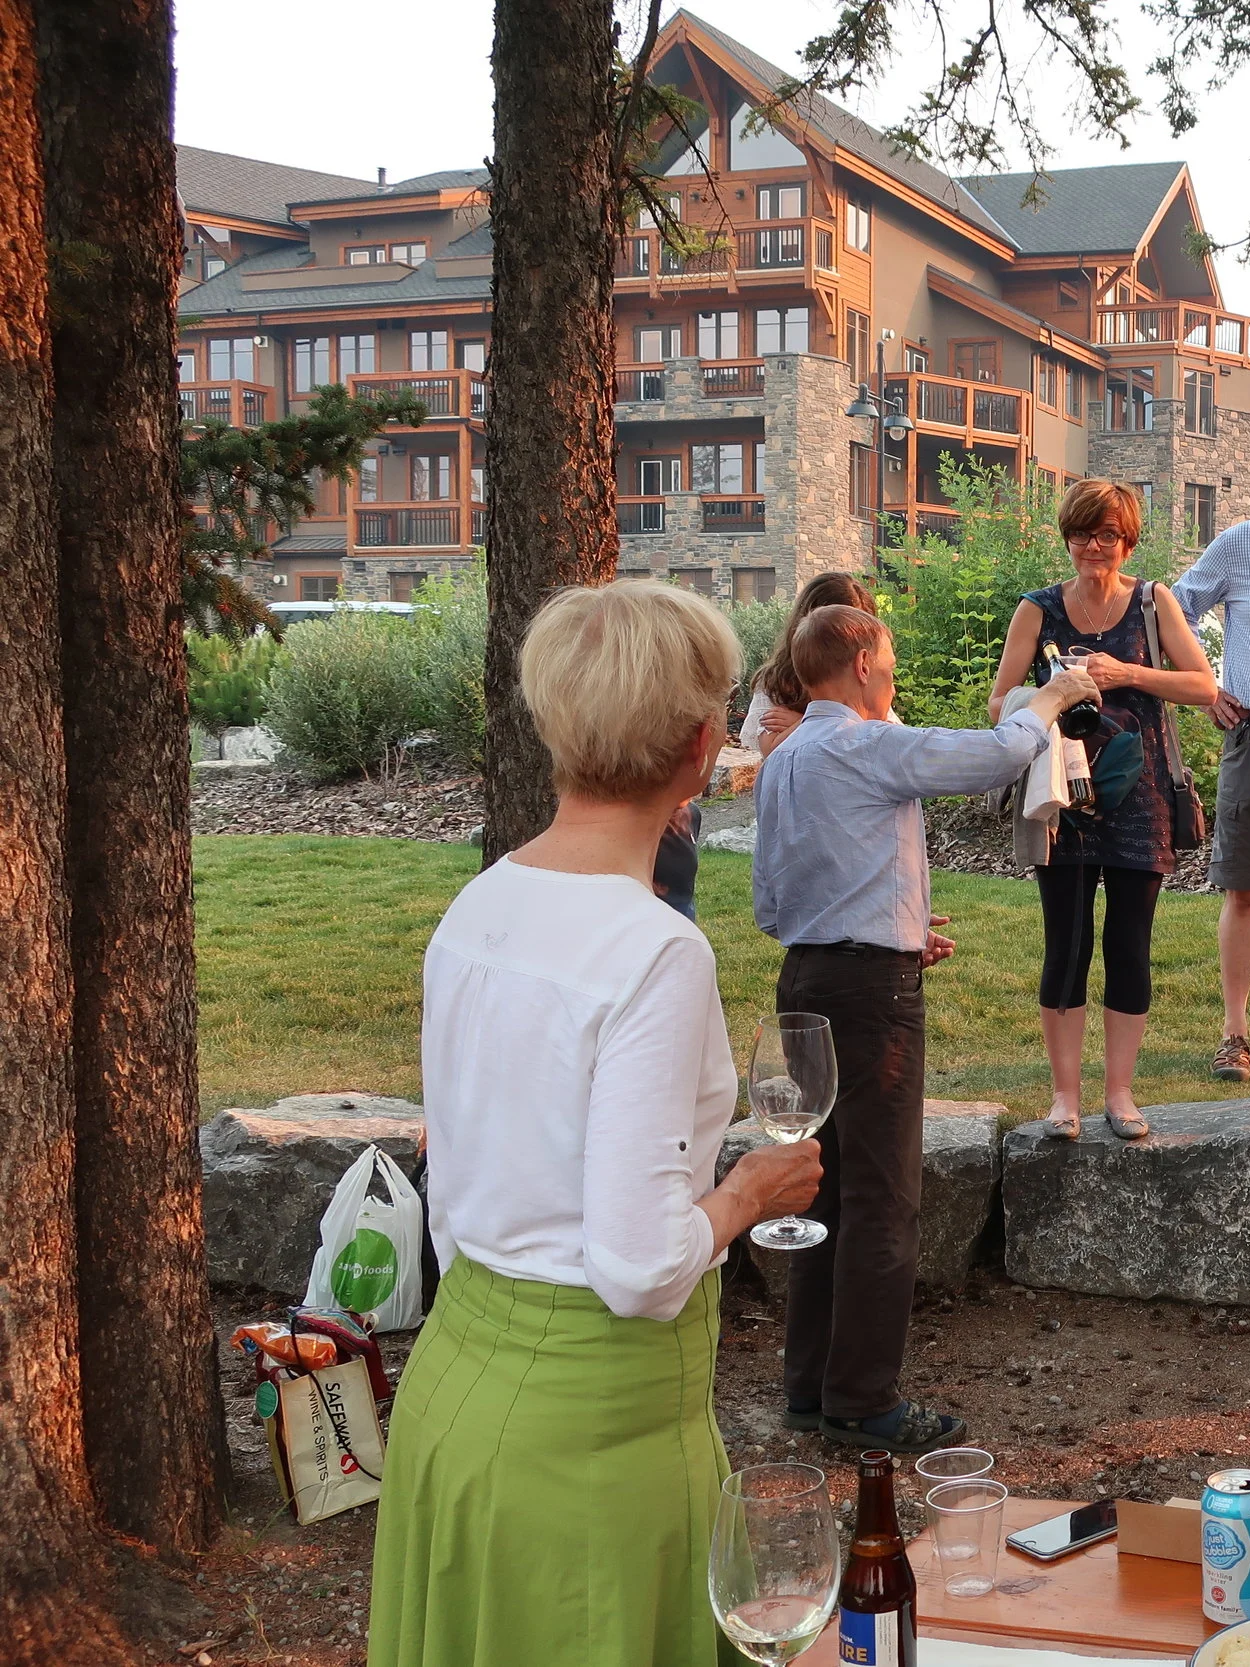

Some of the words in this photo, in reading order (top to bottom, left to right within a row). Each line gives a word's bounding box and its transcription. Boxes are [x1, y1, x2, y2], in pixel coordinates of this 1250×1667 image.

[364, 1263, 394, 1275] foods
[308, 1389, 320, 1423] WINE
[325, 1382, 353, 1450] SAFEWAY
[313, 1426, 324, 1435] &
[314, 1435, 329, 1482] SPIRITS
